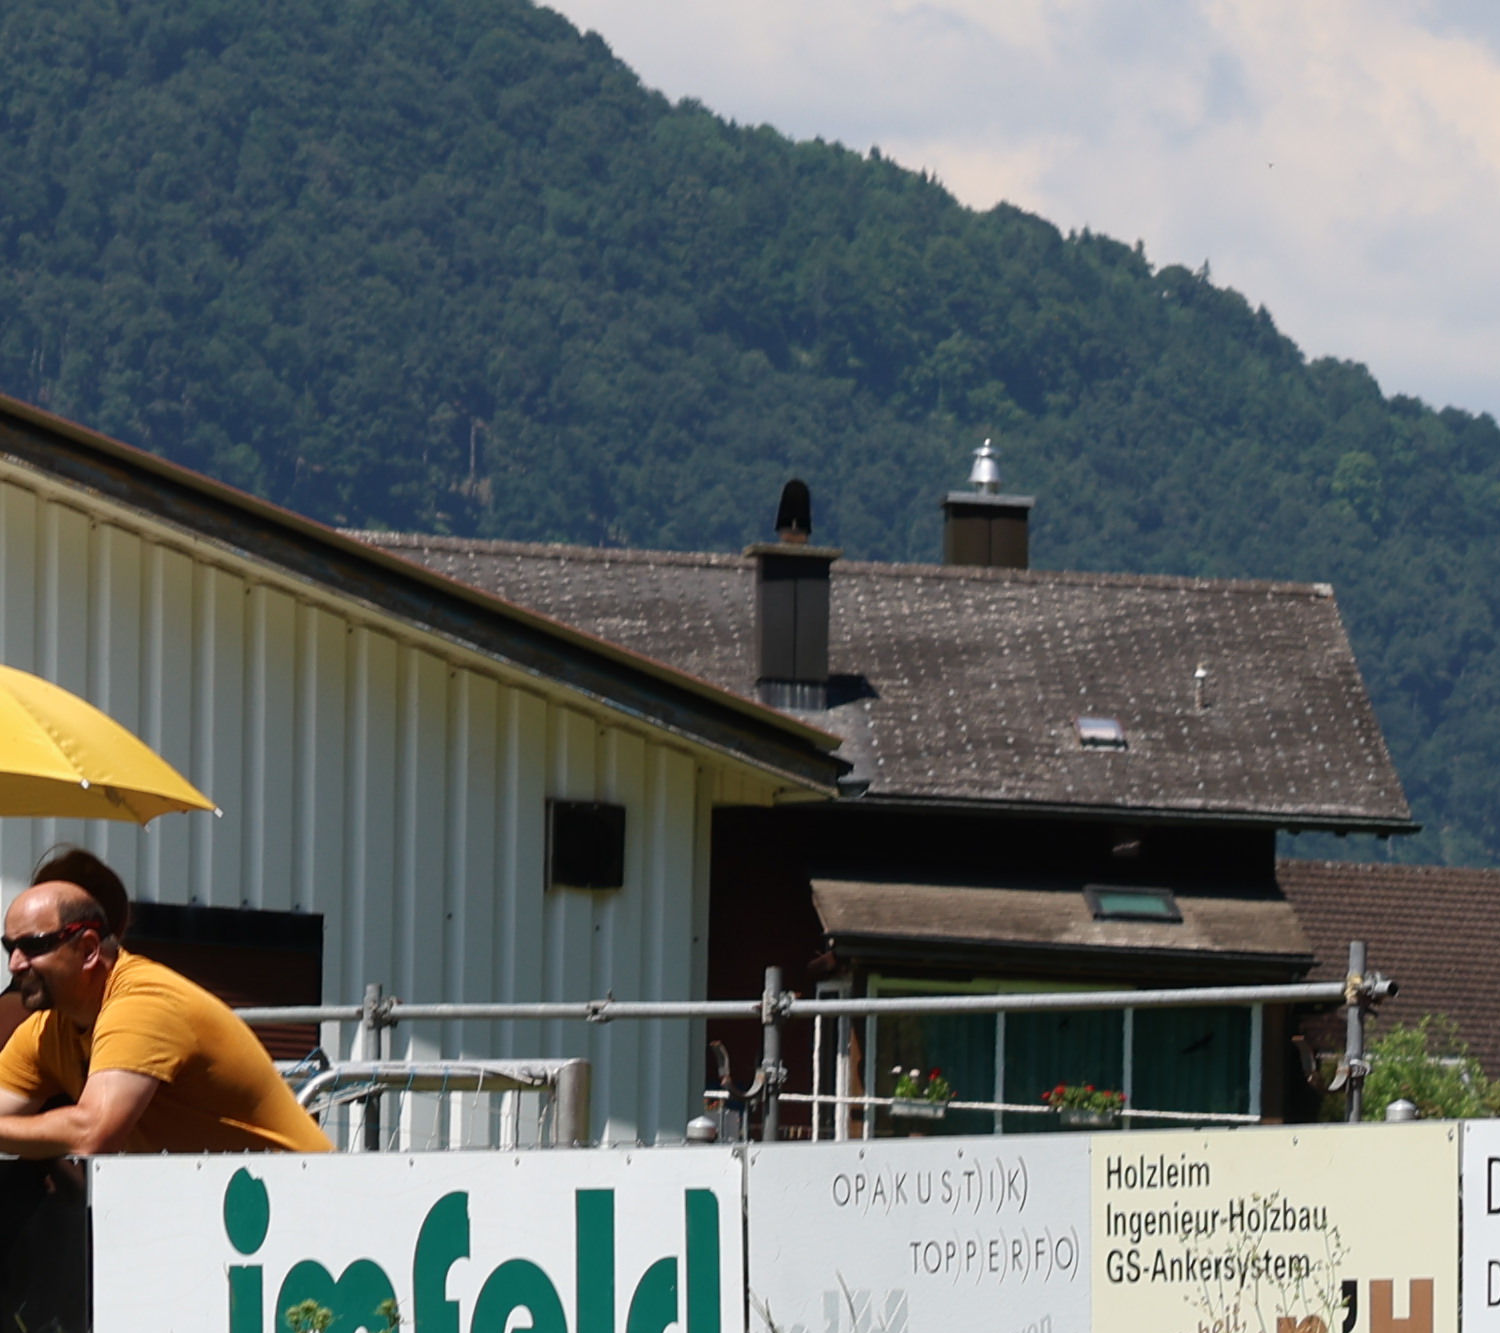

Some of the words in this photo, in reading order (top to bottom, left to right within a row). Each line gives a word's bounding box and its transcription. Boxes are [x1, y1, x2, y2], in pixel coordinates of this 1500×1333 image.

[1106, 1154, 1211, 1190] Holzleim
[1106, 1197, 1328, 1244] Ingenieur-Holzbau
[1106, 1247, 1312, 1289] GS-Ankersystem
